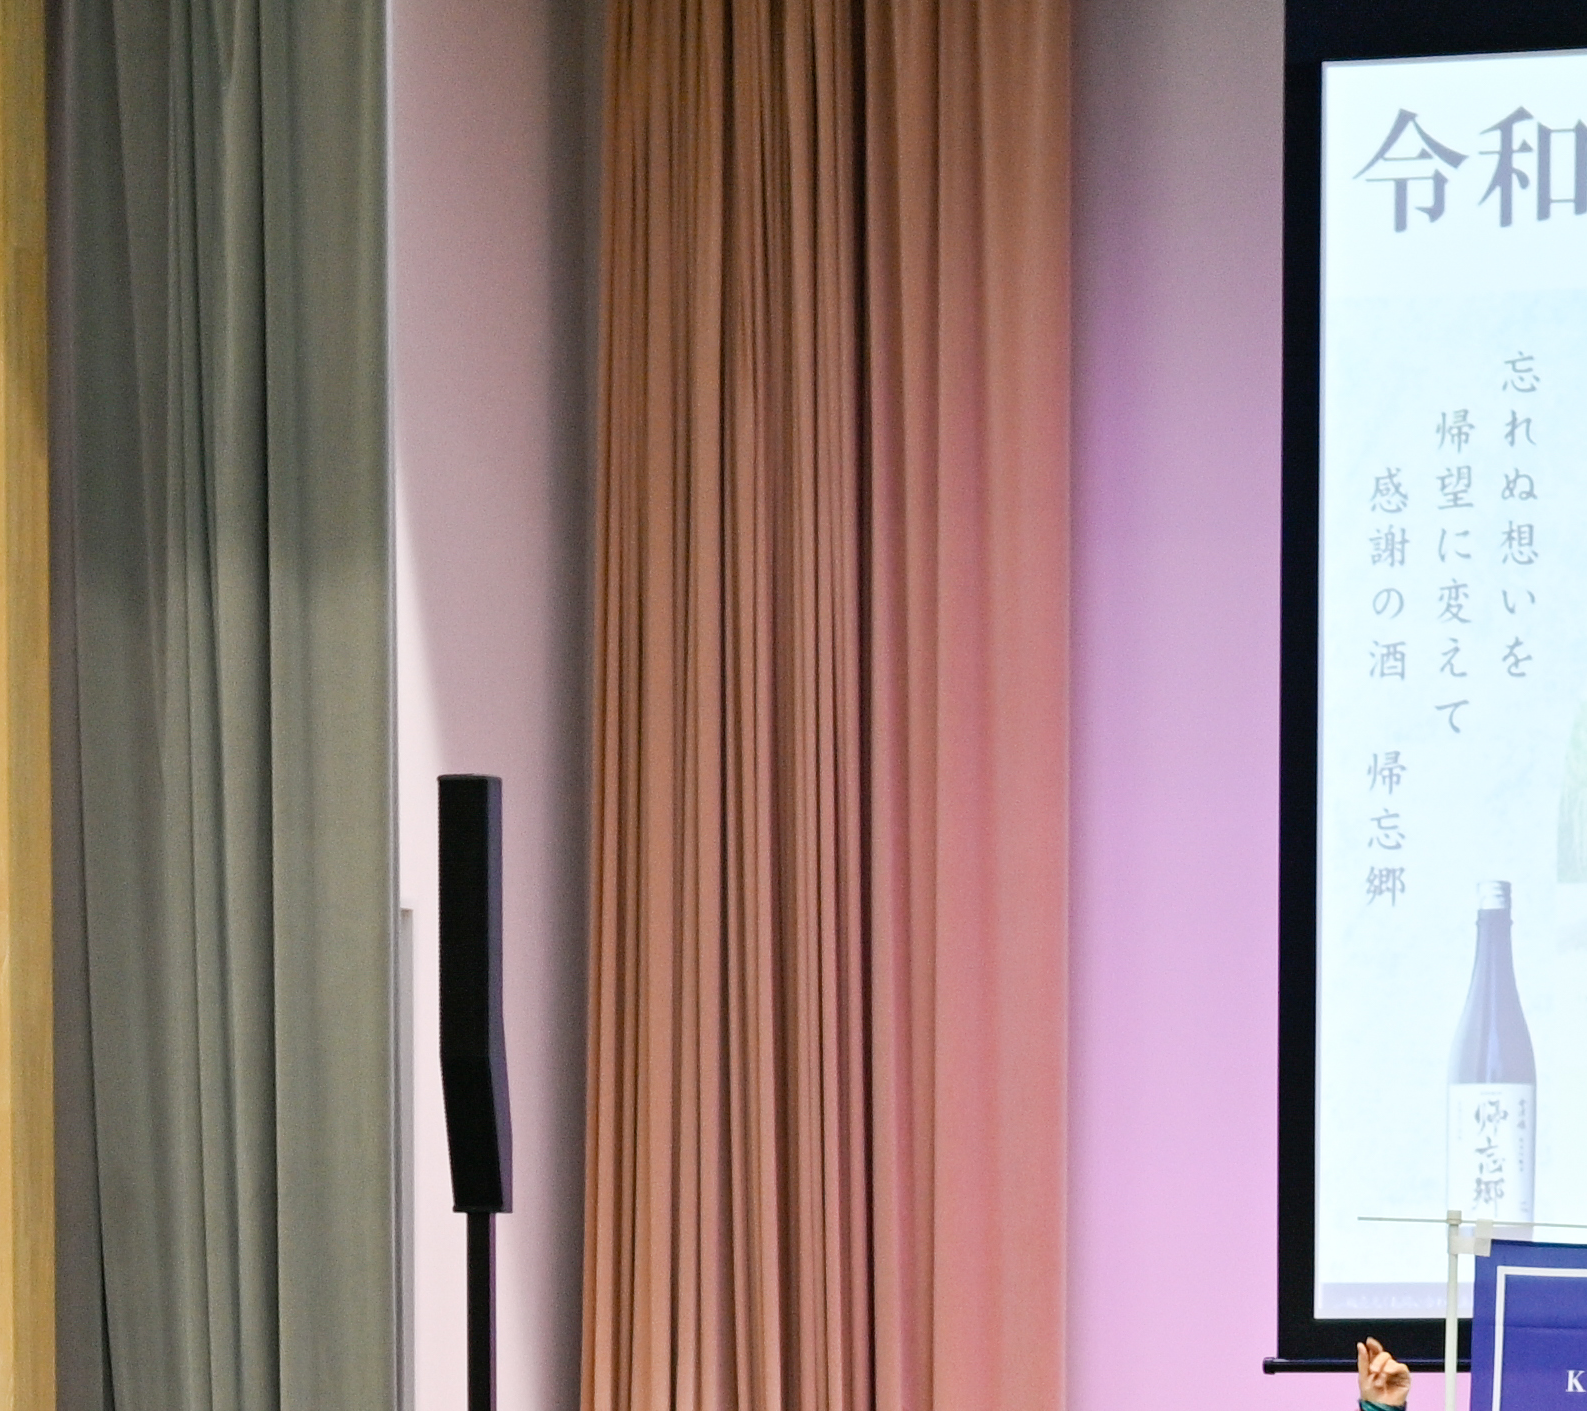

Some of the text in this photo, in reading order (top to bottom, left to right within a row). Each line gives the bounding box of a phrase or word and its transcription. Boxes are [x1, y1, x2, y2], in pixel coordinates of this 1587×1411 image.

[1434, 407, 1476, 735] 帰望に変えて
[1501, 350, 1541, 679] 忘れぬ想いを
[1365, 467, 1410, 908] 感謝の酒 帰忘郷
